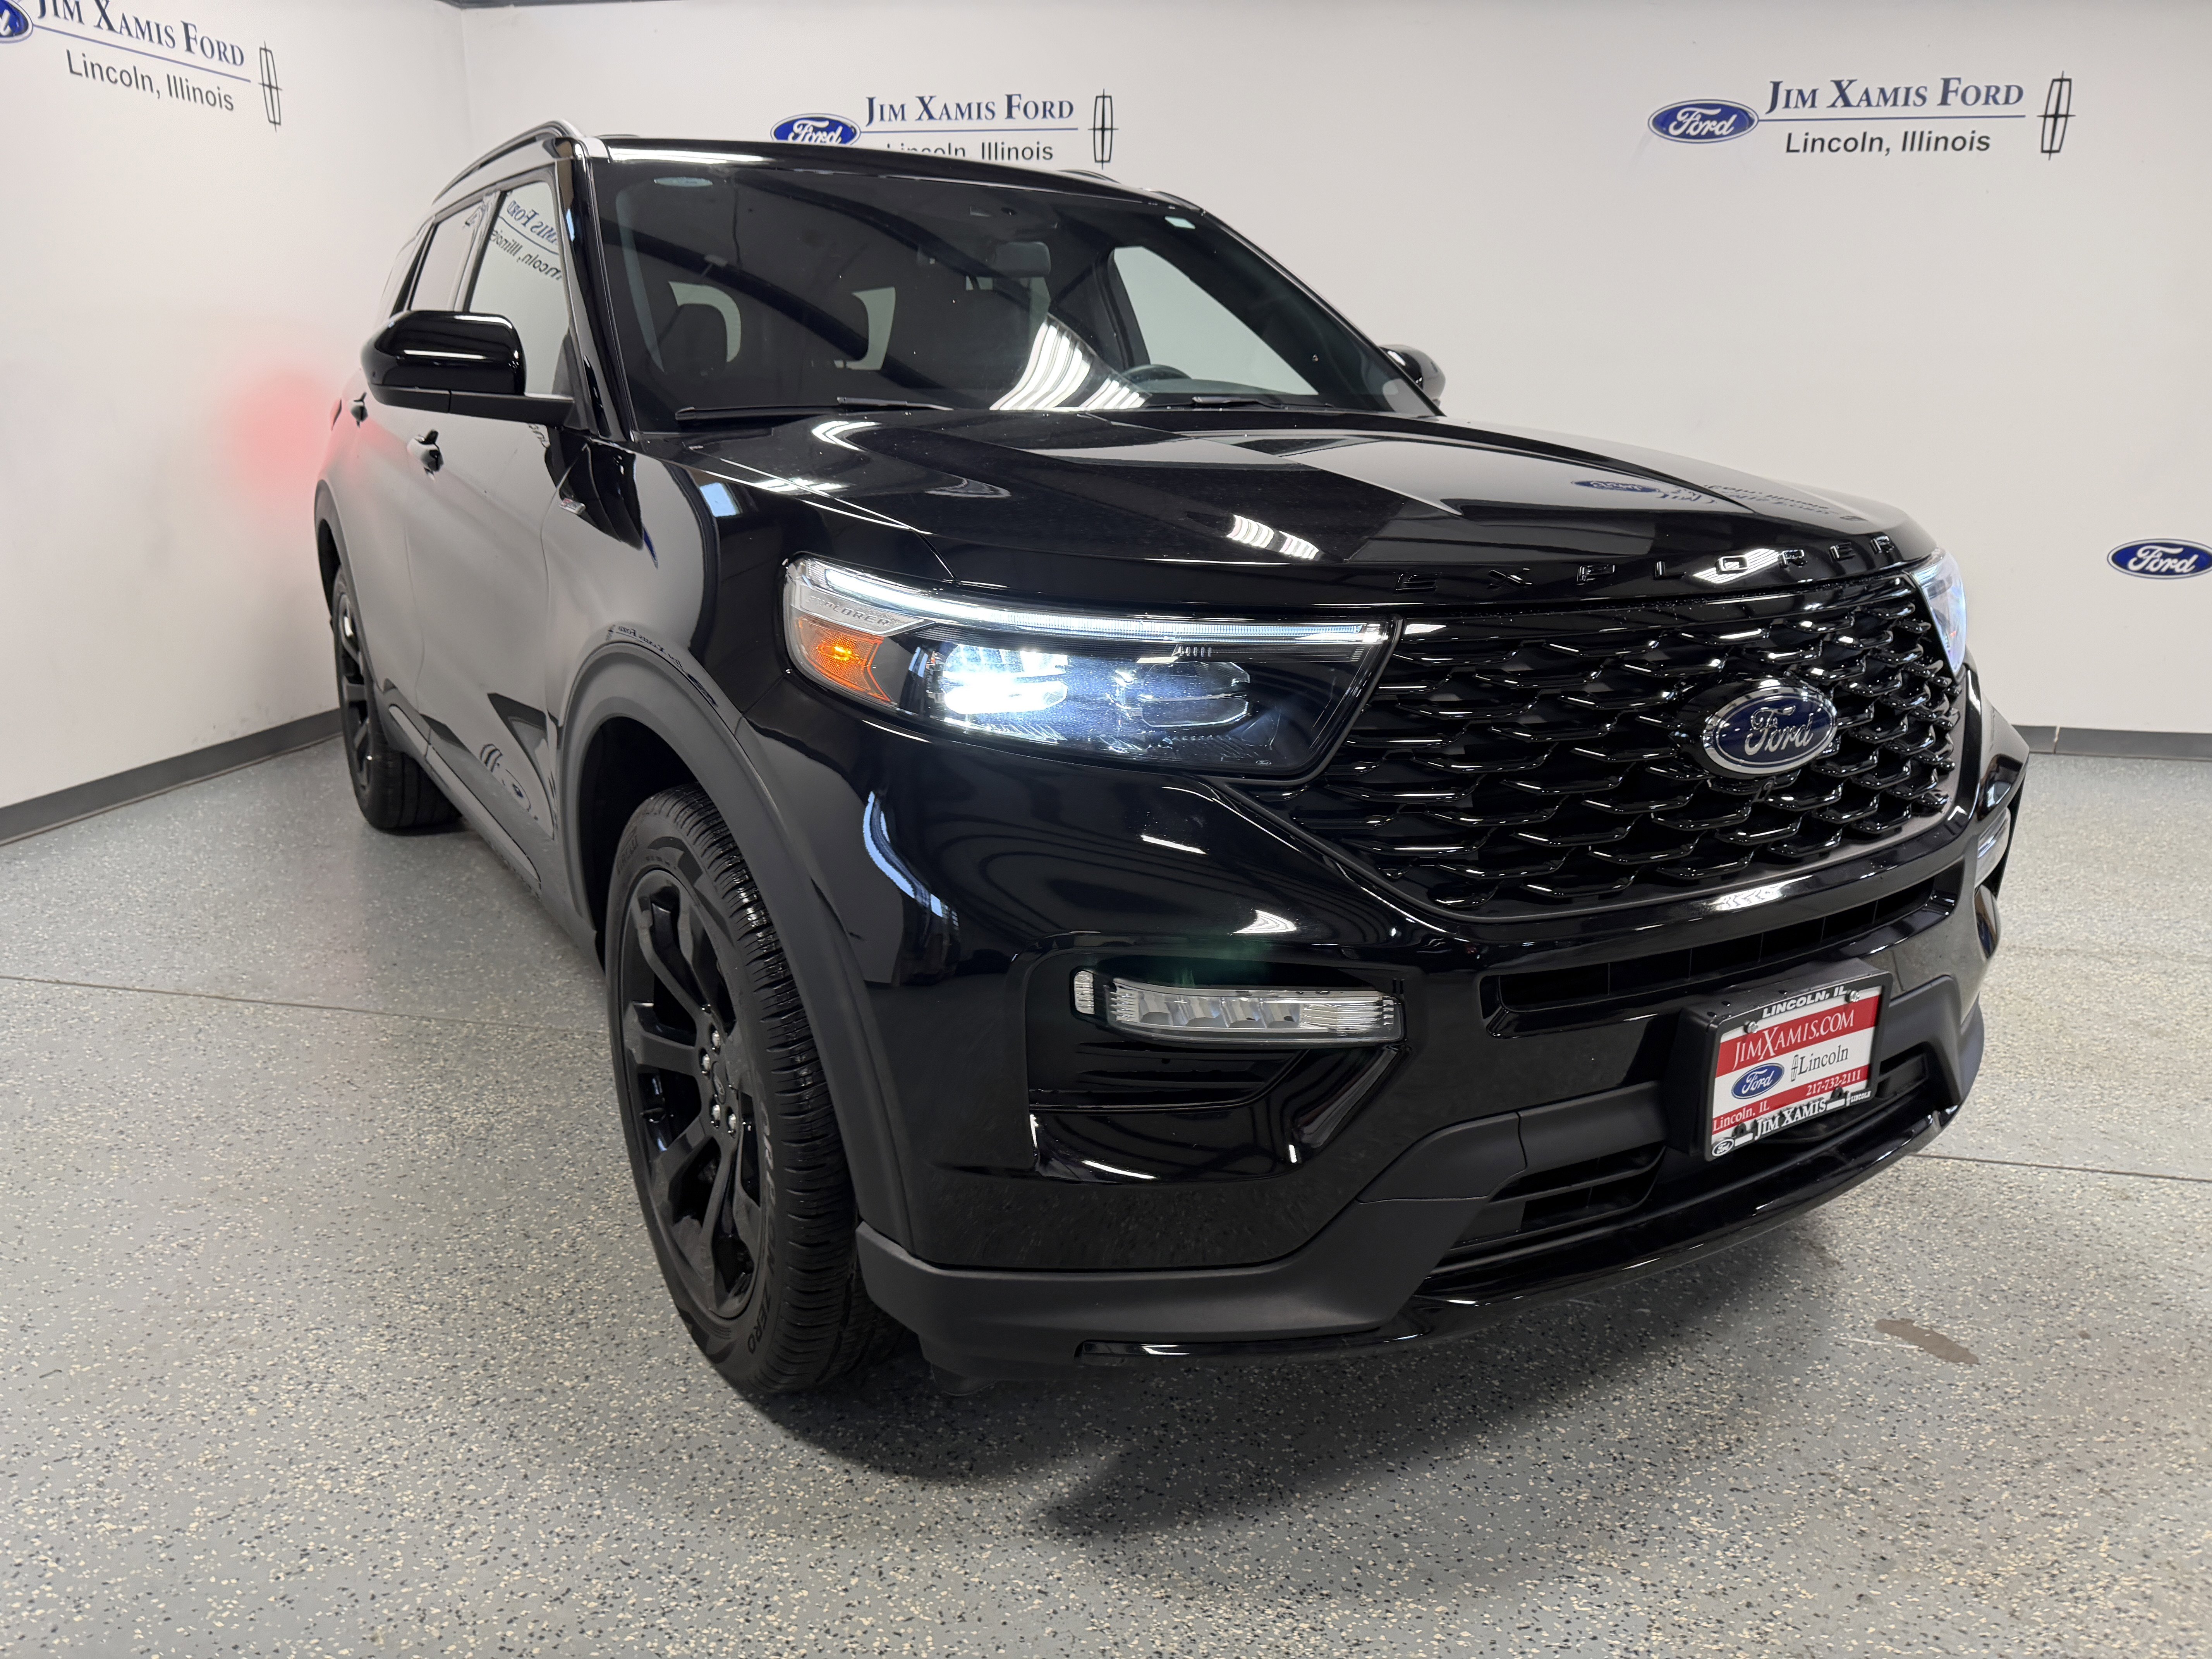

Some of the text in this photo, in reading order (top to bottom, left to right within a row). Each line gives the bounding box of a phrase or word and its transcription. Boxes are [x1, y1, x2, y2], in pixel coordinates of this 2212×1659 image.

[94, 0, 176, 49] XAMIS
[180, 21, 245, 66] FORD
[66, 50, 234, 111] Lincoln, Illinois
[866, 94, 1074, 127] JIM XAMIS FORD
[1765, 77, 2024, 115] JIM XAMIS FORD
[787, 119, 843, 143] Ford
[1667, 107, 1735, 136] Ford
[982, 141, 1053, 161] Illinois
[1786, 130, 1990, 156] Lincoln, Illinois
[1395, 536, 1896, 592] EXPLORER
[2128, 545, 2199, 573] Ford
[1744, 705, 1814, 756] Ford
[1762, 990, 1830, 1018] LINCOLN,
[1732, 1010, 1854, 1070] JIMXAMIS.COM
[1799, 1045, 1848, 1075] Lincoln
[1741, 1069, 1773, 1094] Ford
[1806, 1069, 1861, 1096] 217-732-2111
[1850, 1090, 1871, 1103] LINCOLN
[1713, 1100, 1770, 1132] Lincoln, IL
[1754, 1099, 1827, 1140] JIM XAMIS
